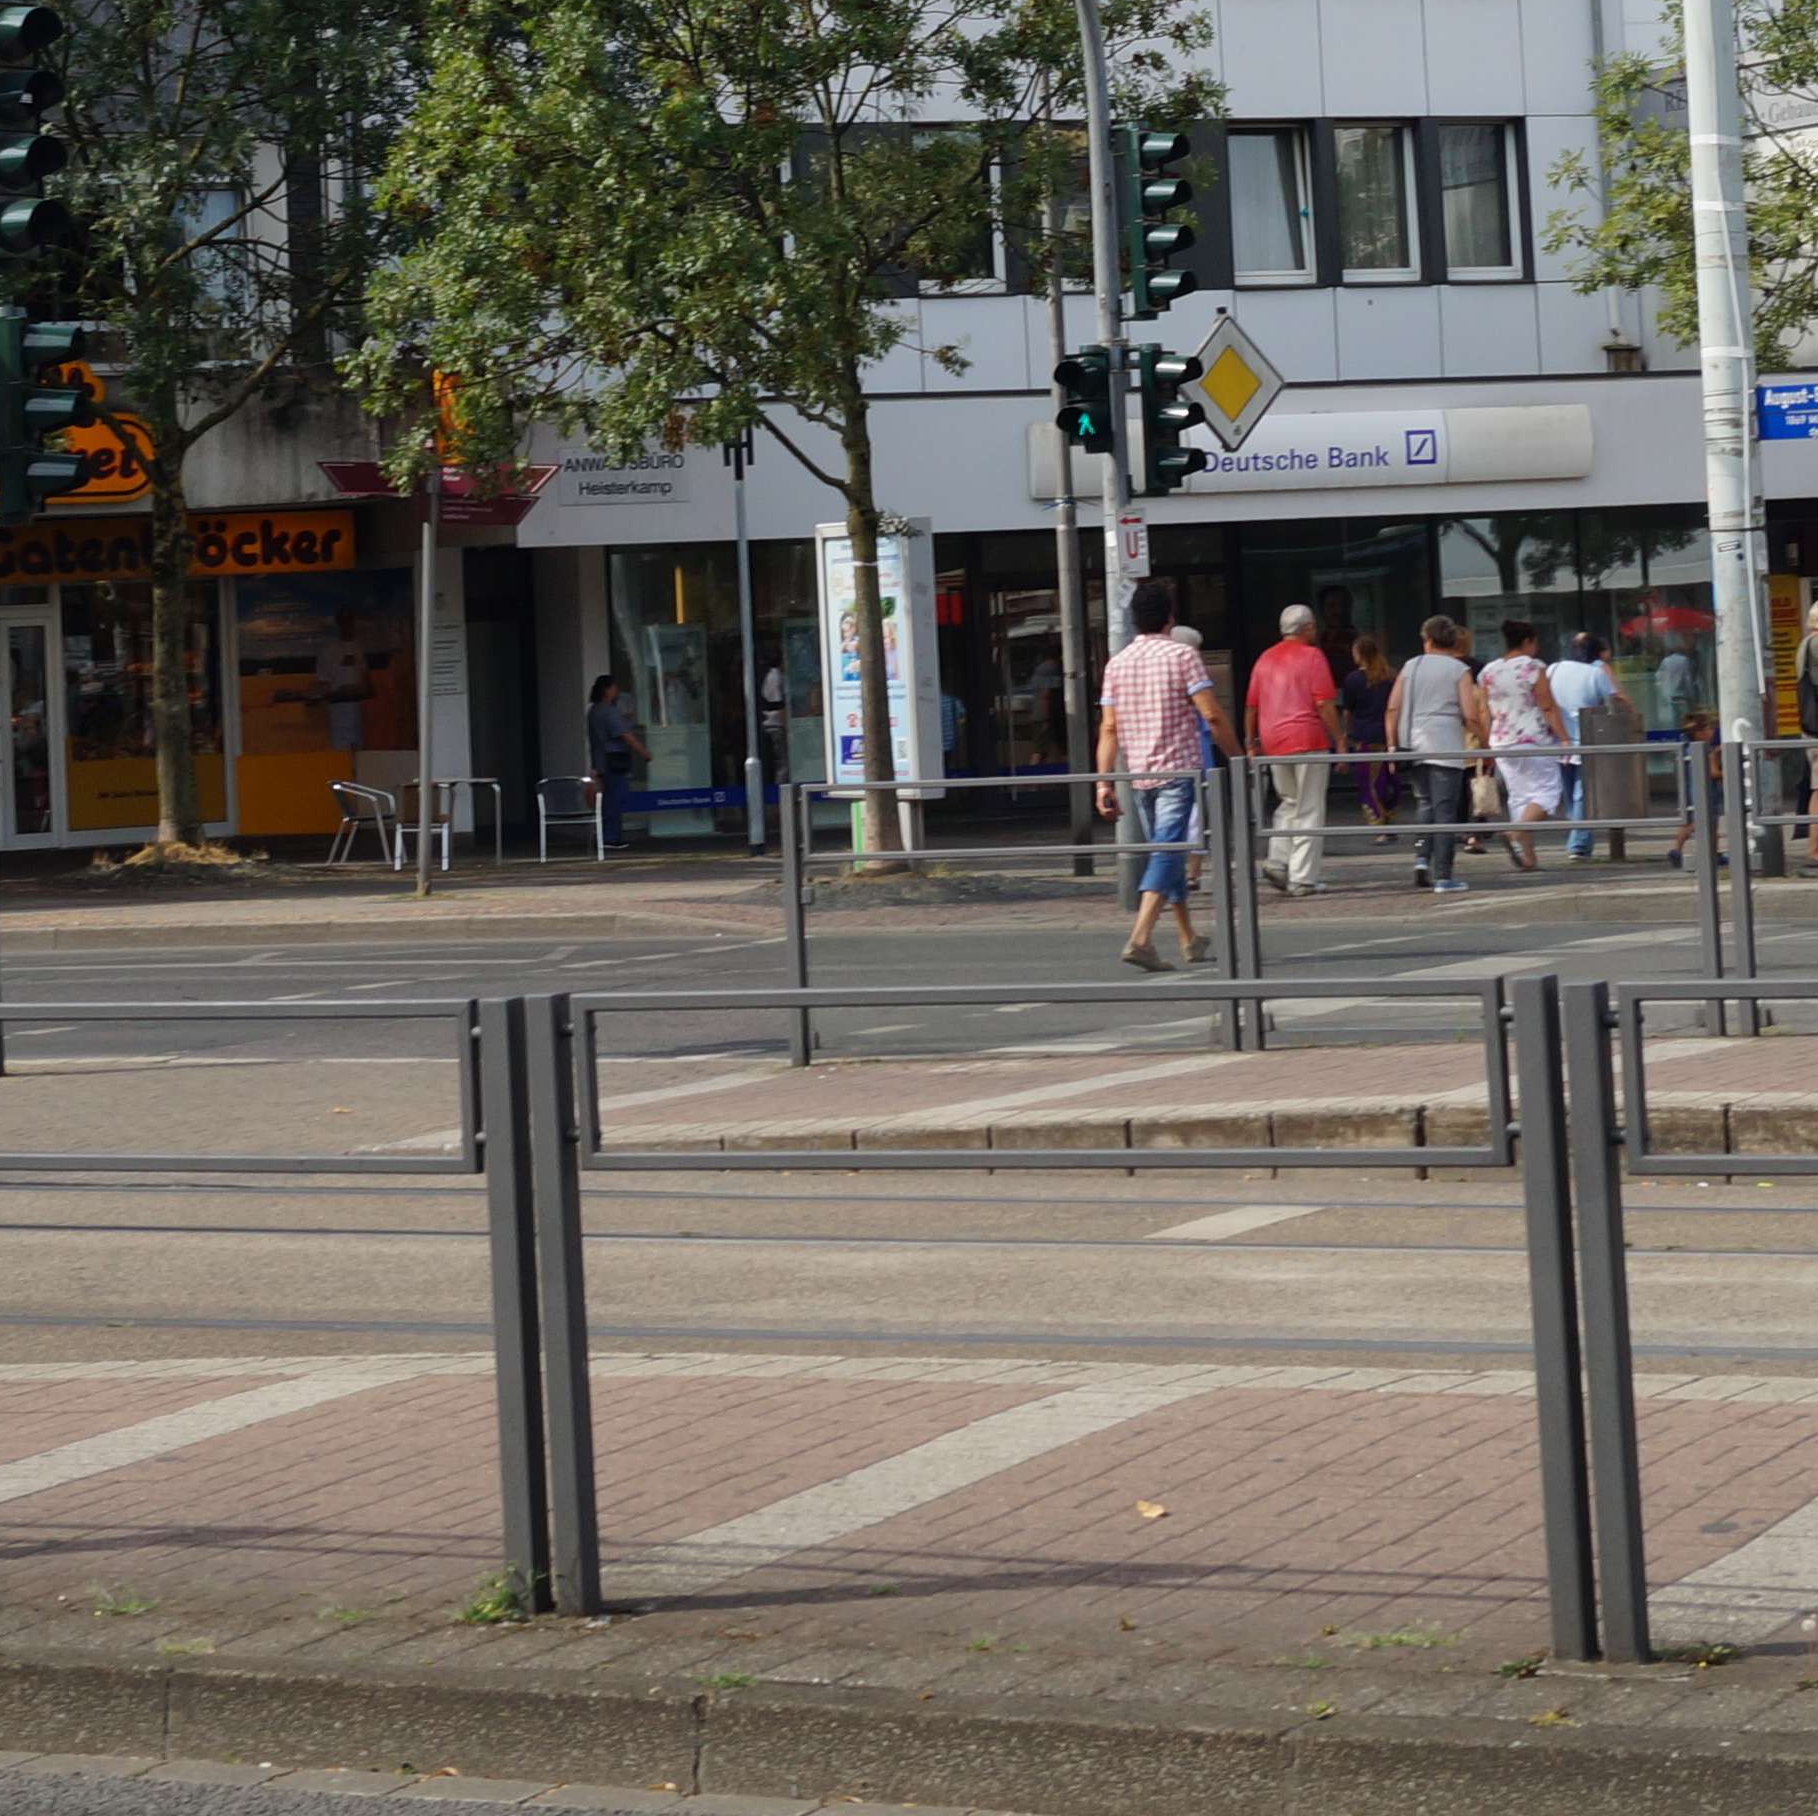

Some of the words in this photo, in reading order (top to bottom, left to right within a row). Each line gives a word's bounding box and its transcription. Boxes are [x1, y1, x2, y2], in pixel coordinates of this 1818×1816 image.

[1203, 449, 1319, 473] Deutsche
[1328, 445, 1390, 469] Bank
[578, 481, 673, 496] Heisterkamp
